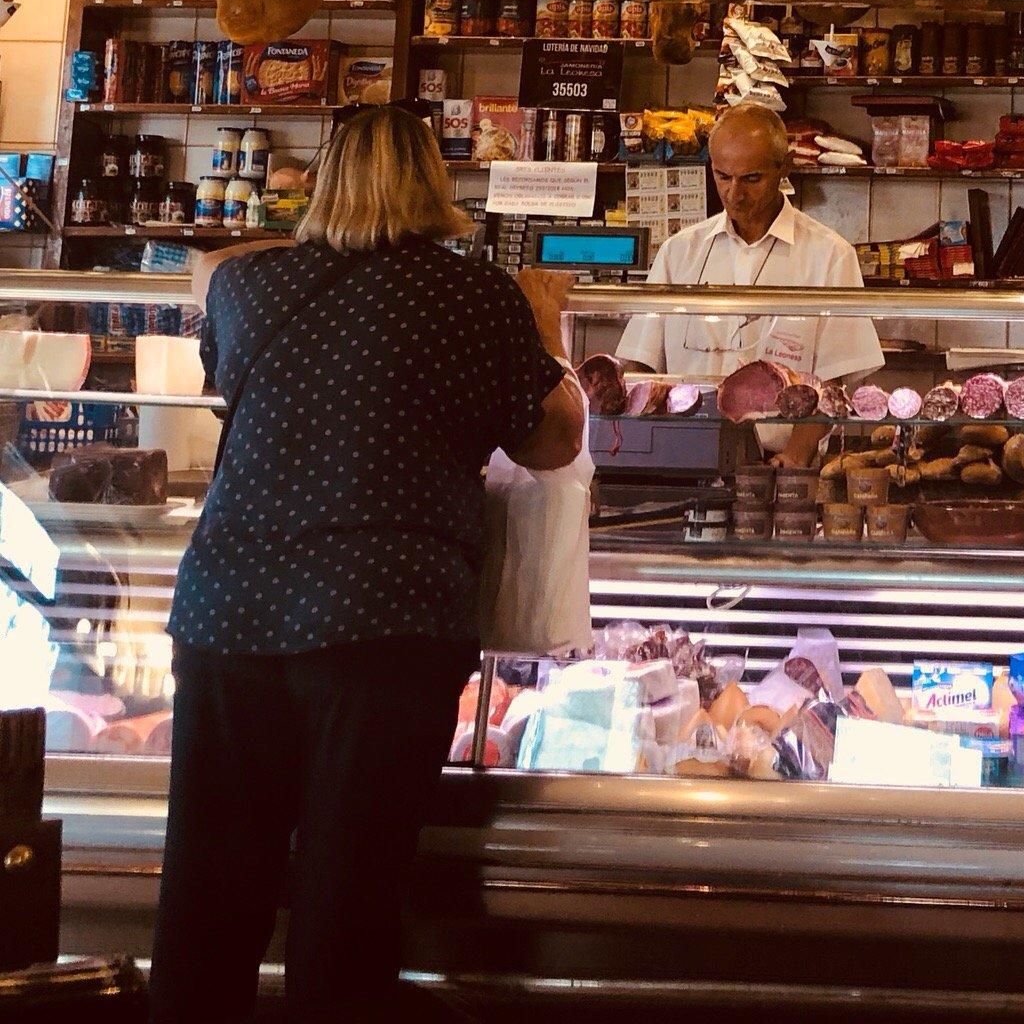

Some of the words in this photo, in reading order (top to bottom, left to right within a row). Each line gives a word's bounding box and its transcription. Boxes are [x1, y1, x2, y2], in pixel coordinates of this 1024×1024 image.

[268, 46, 308, 56] FONTANEDA
[543, 43, 569, 52] LOTERÍA
[570, 44, 578, 53] DE
[580, 44, 608, 53] NAVIDAD
[421, 82, 443, 93] SOS
[552, 82, 588, 97] 35503
[479, 102, 518, 113] brillante
[445, 118, 468, 129] SOS
[926, 688, 977, 709] Actimel
